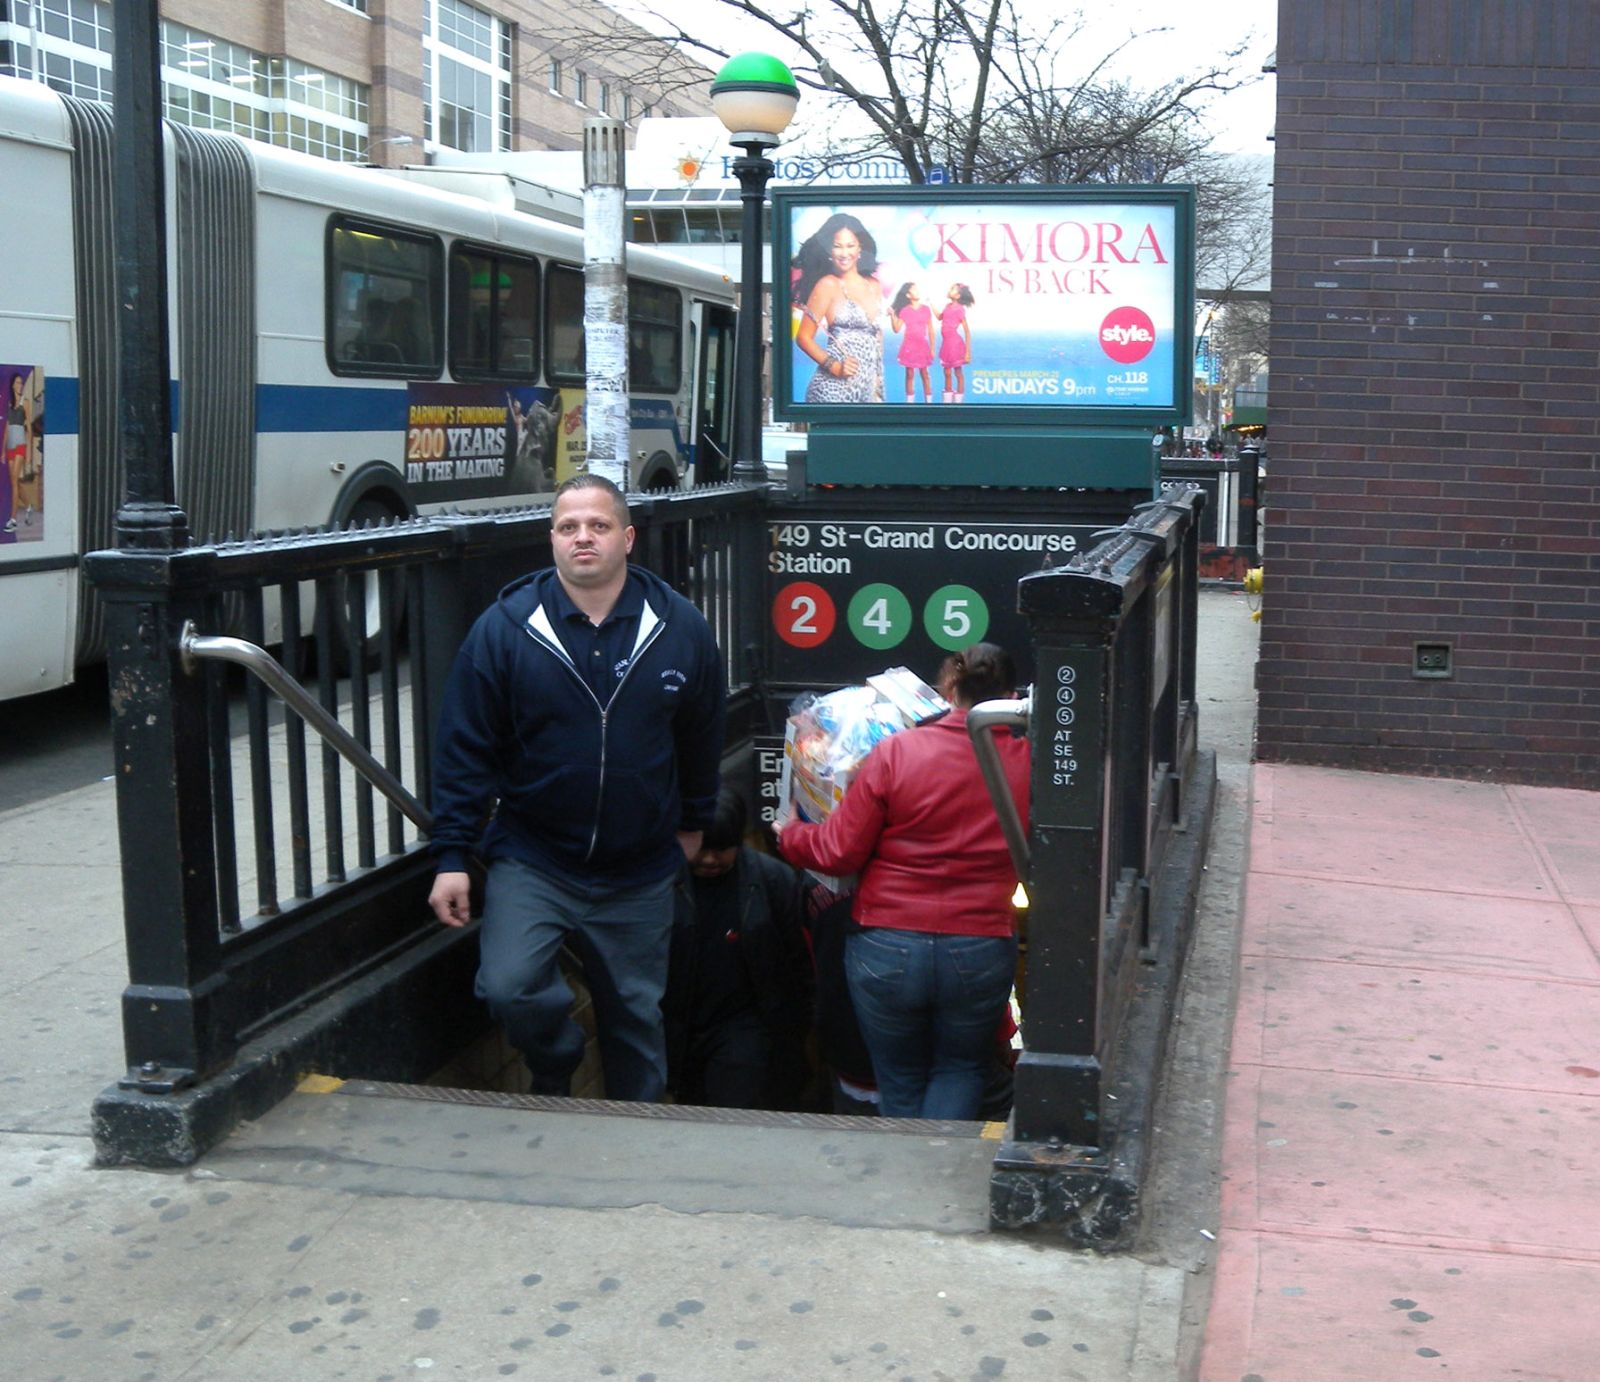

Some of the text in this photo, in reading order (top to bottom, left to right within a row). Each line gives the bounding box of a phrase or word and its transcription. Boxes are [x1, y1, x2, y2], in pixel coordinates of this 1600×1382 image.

[934, 222, 1168, 263] KIMORA
[987, 269, 1112, 294] IS BACK
[1102, 325, 1152, 344] style.
[972, 377, 1060, 395] SUNDAYS
[410, 405, 455, 424] BARNUM'S
[408, 427, 507, 459] 200 YEARS
[407, 458, 505, 483] IN THE MAKING
[768, 524, 810, 547] 149
[944, 527, 1076, 552] Concourse
[768, 550, 851, 574] Station
[790, 596, 971, 637] 2 4 5
[1054, 730, 1072, 741] AT
[1054, 745, 1073, 756] SE
[1054, 759, 1077, 771] 149
[1053, 774, 1075, 785] ST.
